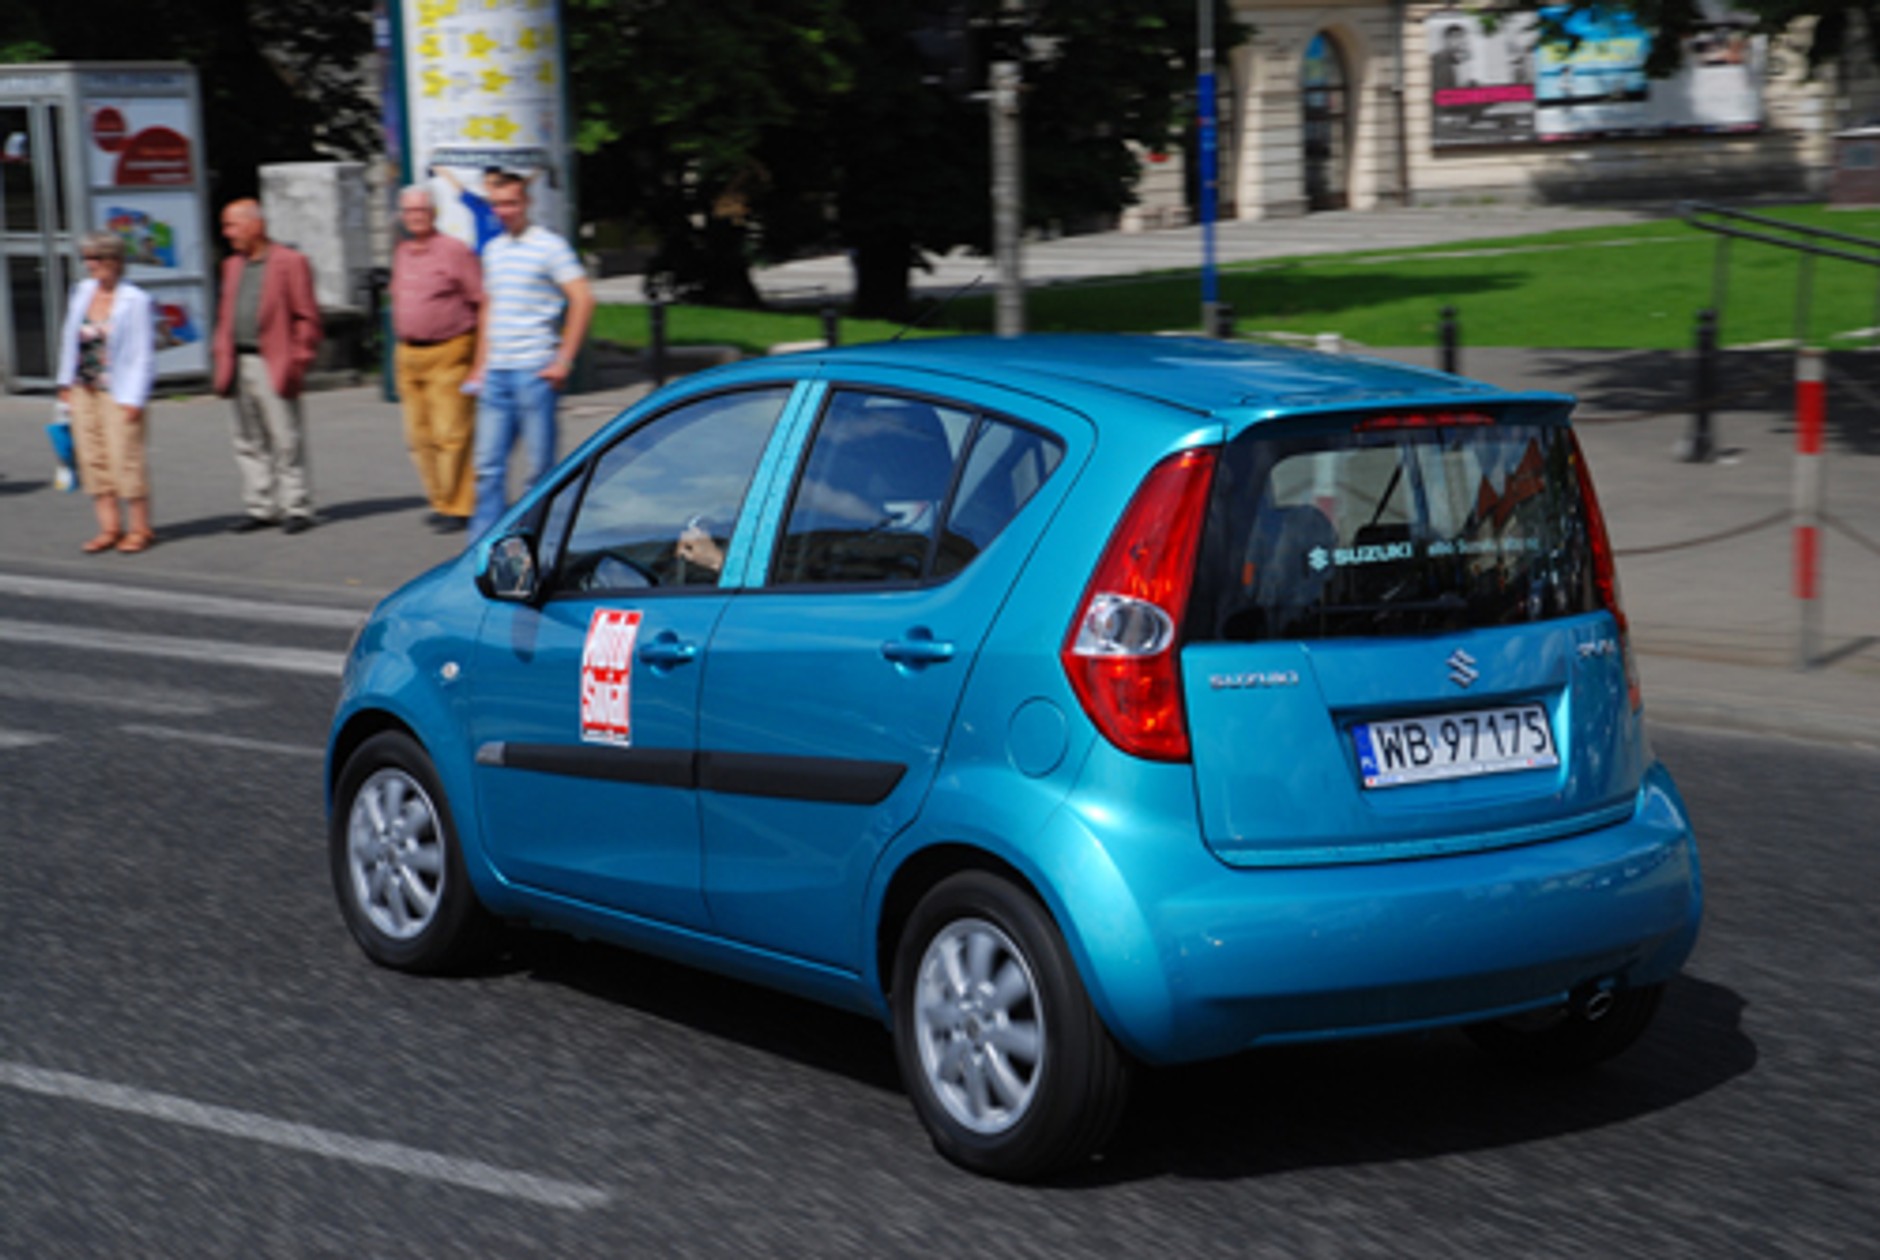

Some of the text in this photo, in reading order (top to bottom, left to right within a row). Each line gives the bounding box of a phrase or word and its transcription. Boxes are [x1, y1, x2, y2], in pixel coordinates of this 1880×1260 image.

[1334, 542, 1413, 565] SUZUKI
[1209, 670, 1299, 690] SUZUKI
[1375, 710, 1547, 769] WB 97175
